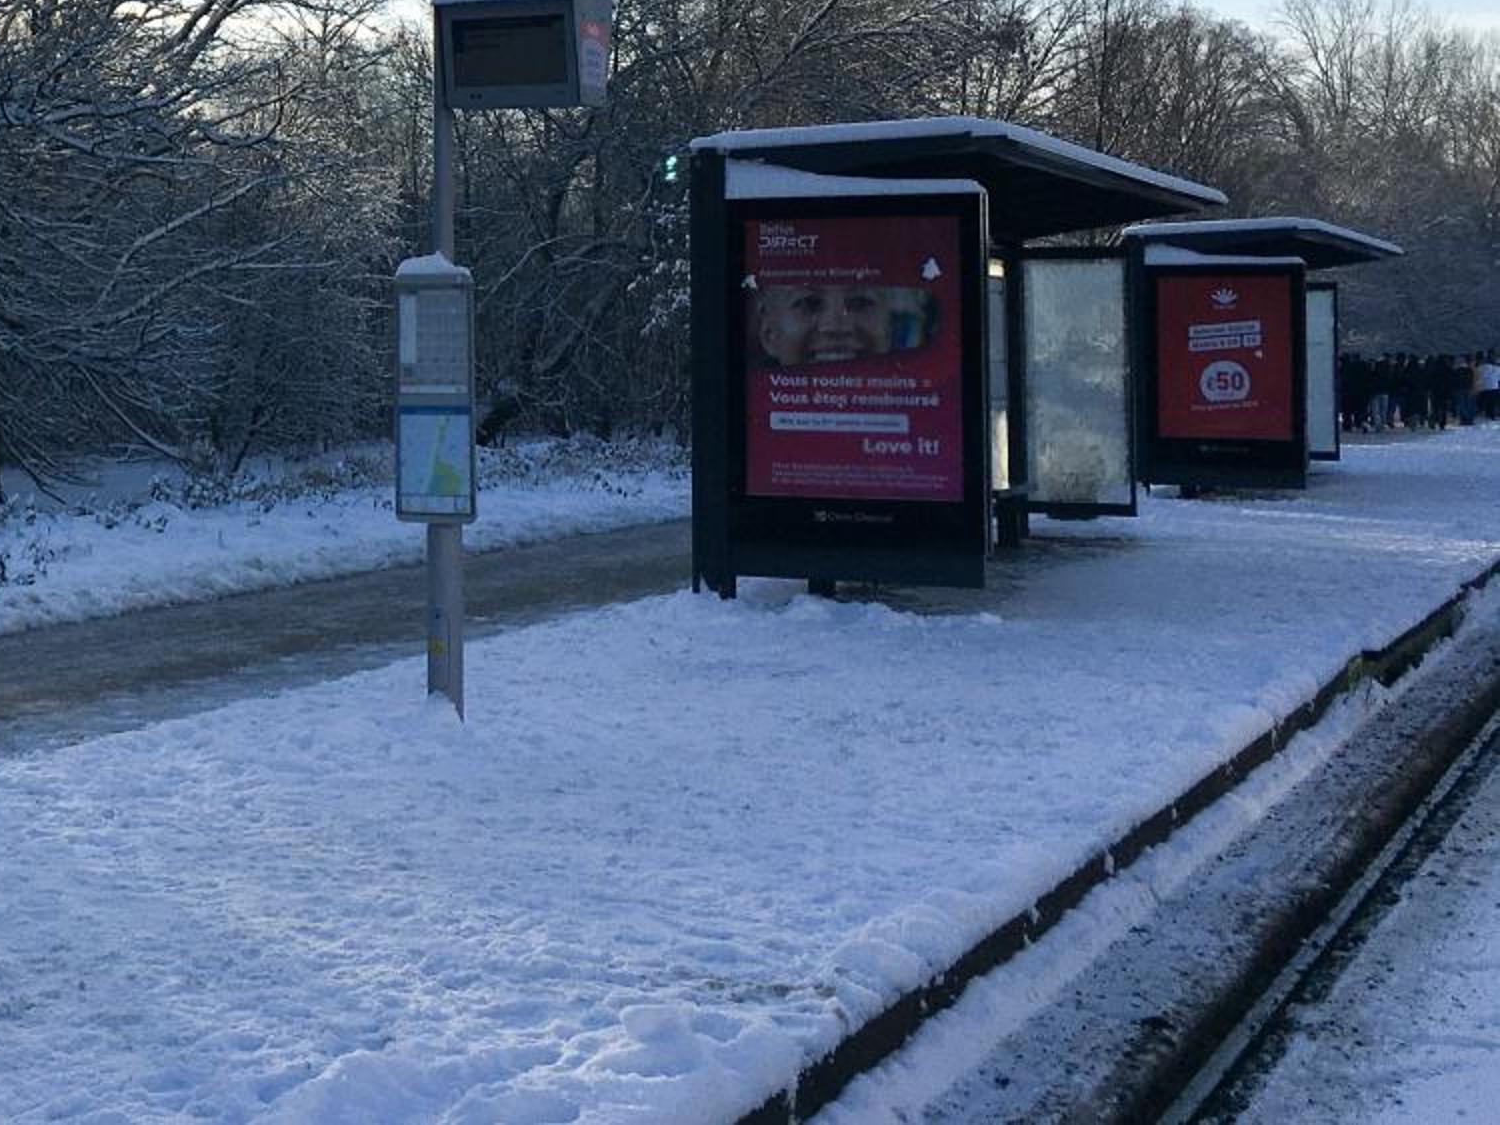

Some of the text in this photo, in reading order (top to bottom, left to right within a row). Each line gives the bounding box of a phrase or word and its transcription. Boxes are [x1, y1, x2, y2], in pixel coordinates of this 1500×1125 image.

[769, 374, 808, 387] Vous
[813, 374, 862, 387] roulez
[769, 391, 808, 404] Vous
[863, 437, 940, 455] Love it!
